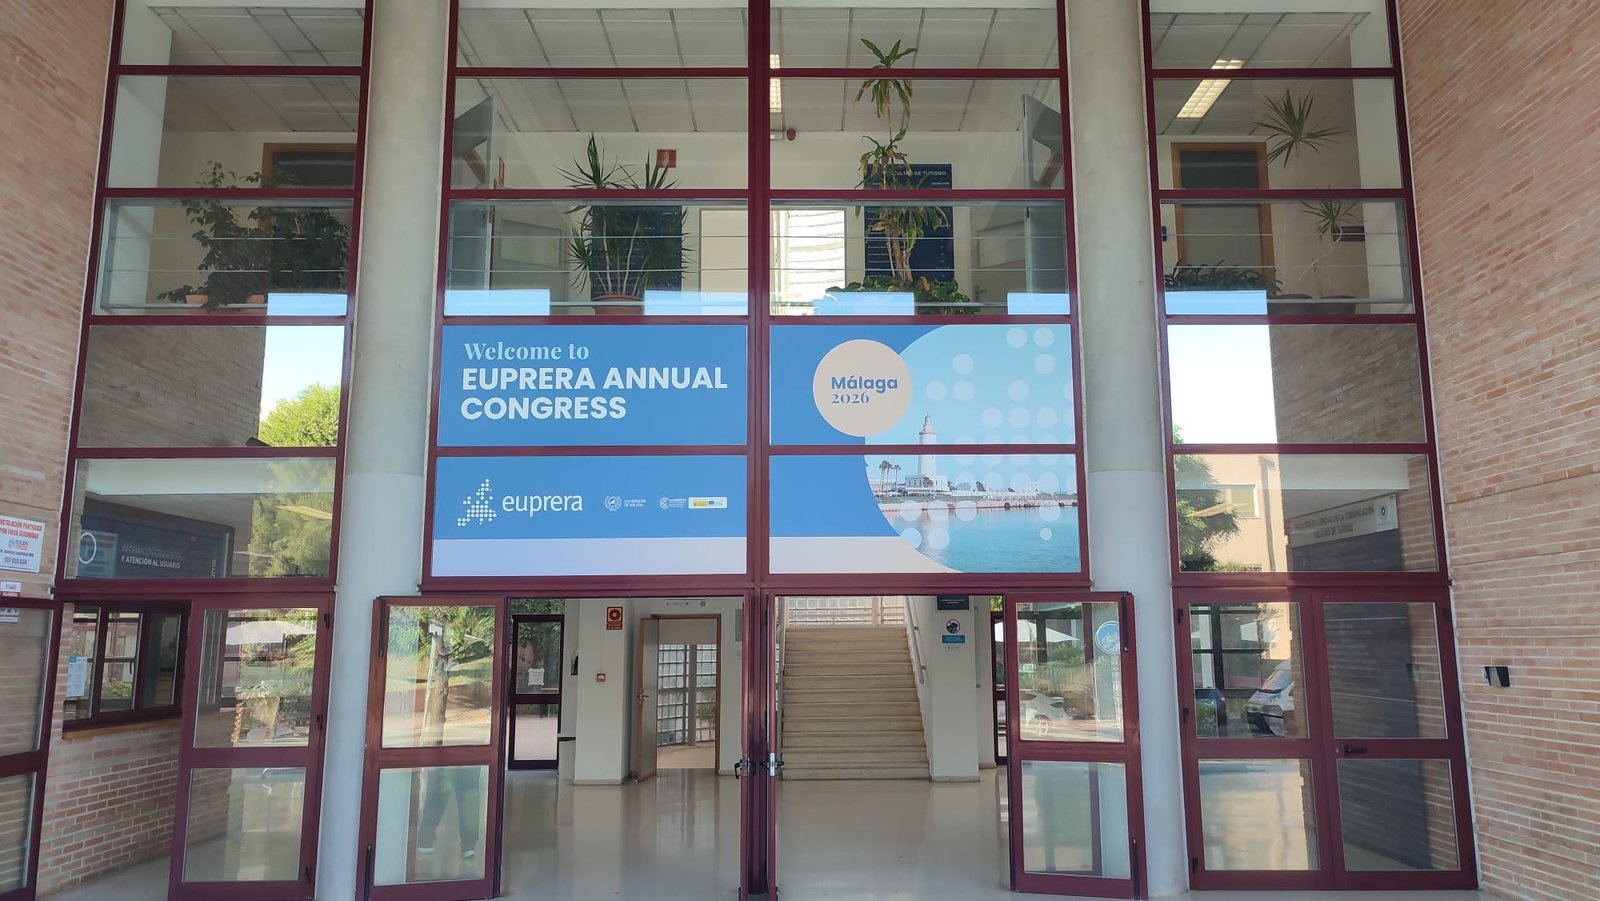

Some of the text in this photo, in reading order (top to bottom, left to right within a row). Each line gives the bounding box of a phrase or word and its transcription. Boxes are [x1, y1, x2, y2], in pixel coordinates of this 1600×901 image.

[464, 341, 589, 360] Welcome to
[462, 366, 728, 390] EUPRERA ANNUAL
[831, 375, 898, 393] Málaga
[831, 391, 870, 404] 2026
[460, 396, 627, 420] CONGRESS
[502, 492, 583, 517] euprera
[126, 556, 151, 566] ATENCIÓN
[152, 559, 160, 567] AL
[160, 560, 181, 569] USUARIO
